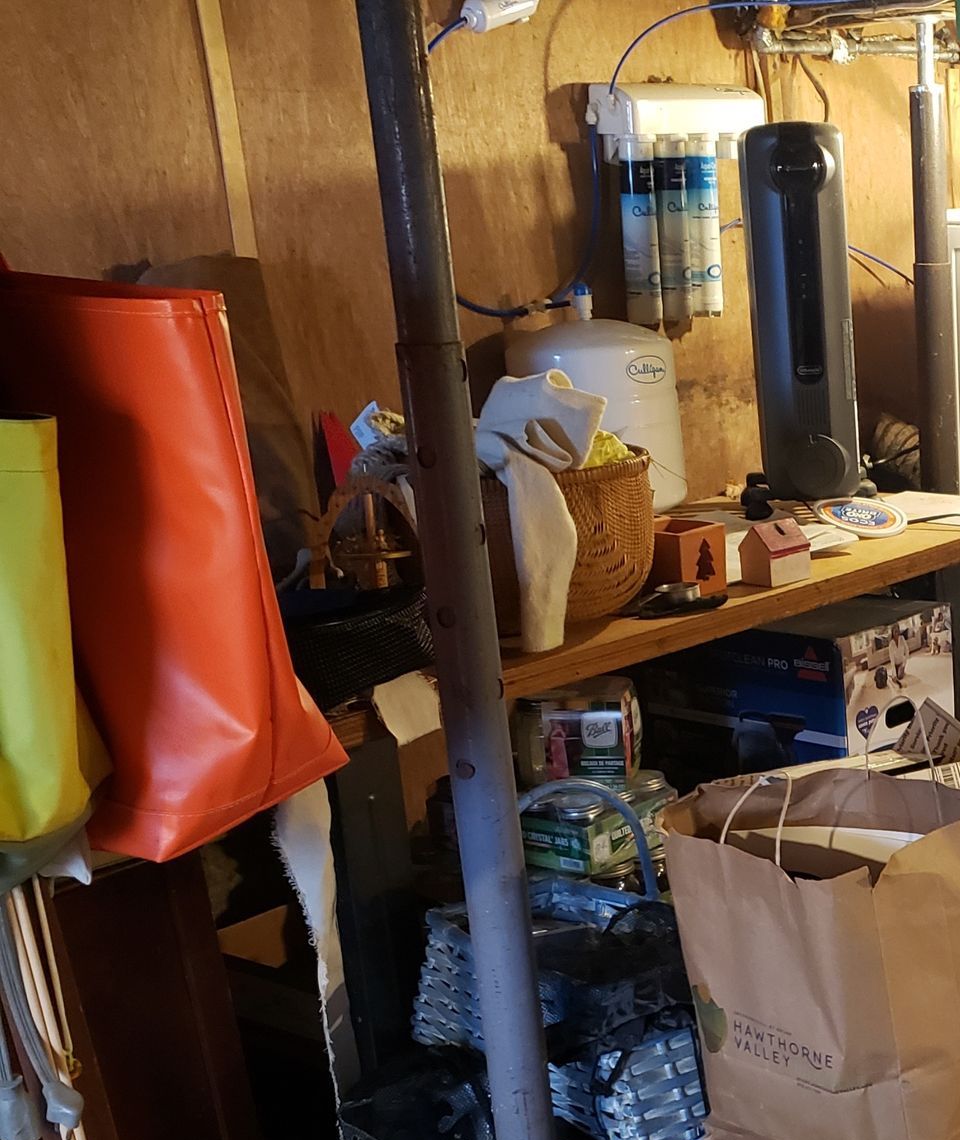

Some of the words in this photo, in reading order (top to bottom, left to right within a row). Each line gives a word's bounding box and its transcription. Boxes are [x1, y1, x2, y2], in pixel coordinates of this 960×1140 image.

[628, 363, 666, 379] Culligan
[842, 515, 876, 526] ECOS
[767, 657, 789, 671] PRO
[585, 720, 612, 739] Ball
[734, 1020, 833, 1070] HAWTHORNE
[735, 1035, 791, 1067] VALLEY
